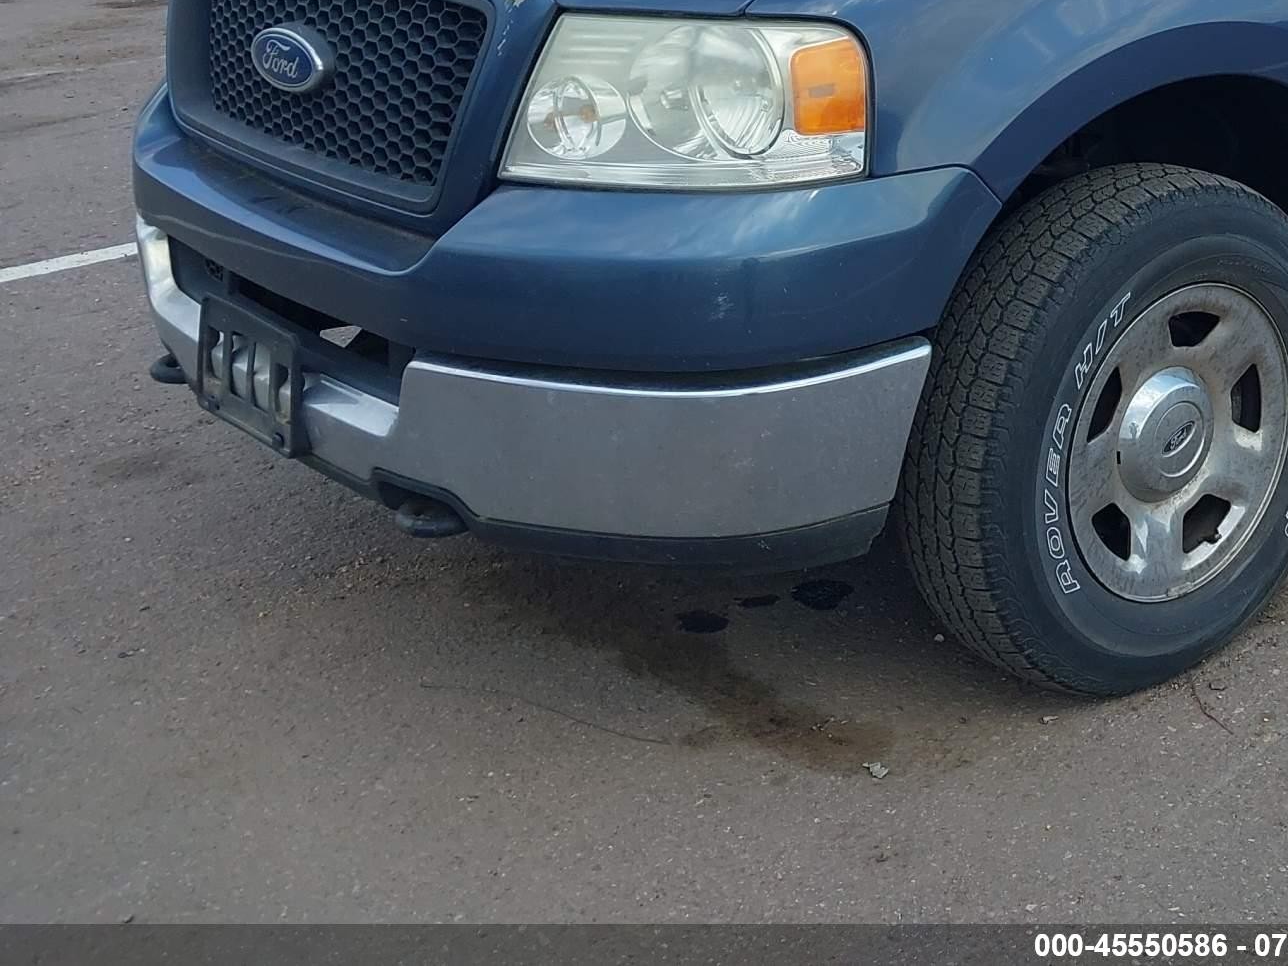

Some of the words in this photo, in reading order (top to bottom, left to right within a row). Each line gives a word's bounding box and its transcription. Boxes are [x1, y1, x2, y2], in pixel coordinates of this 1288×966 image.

[262, 39, 299, 79] Ford
[1044, 403, 1081, 594] ROVER
[1075, 292, 1131, 390] H/T
